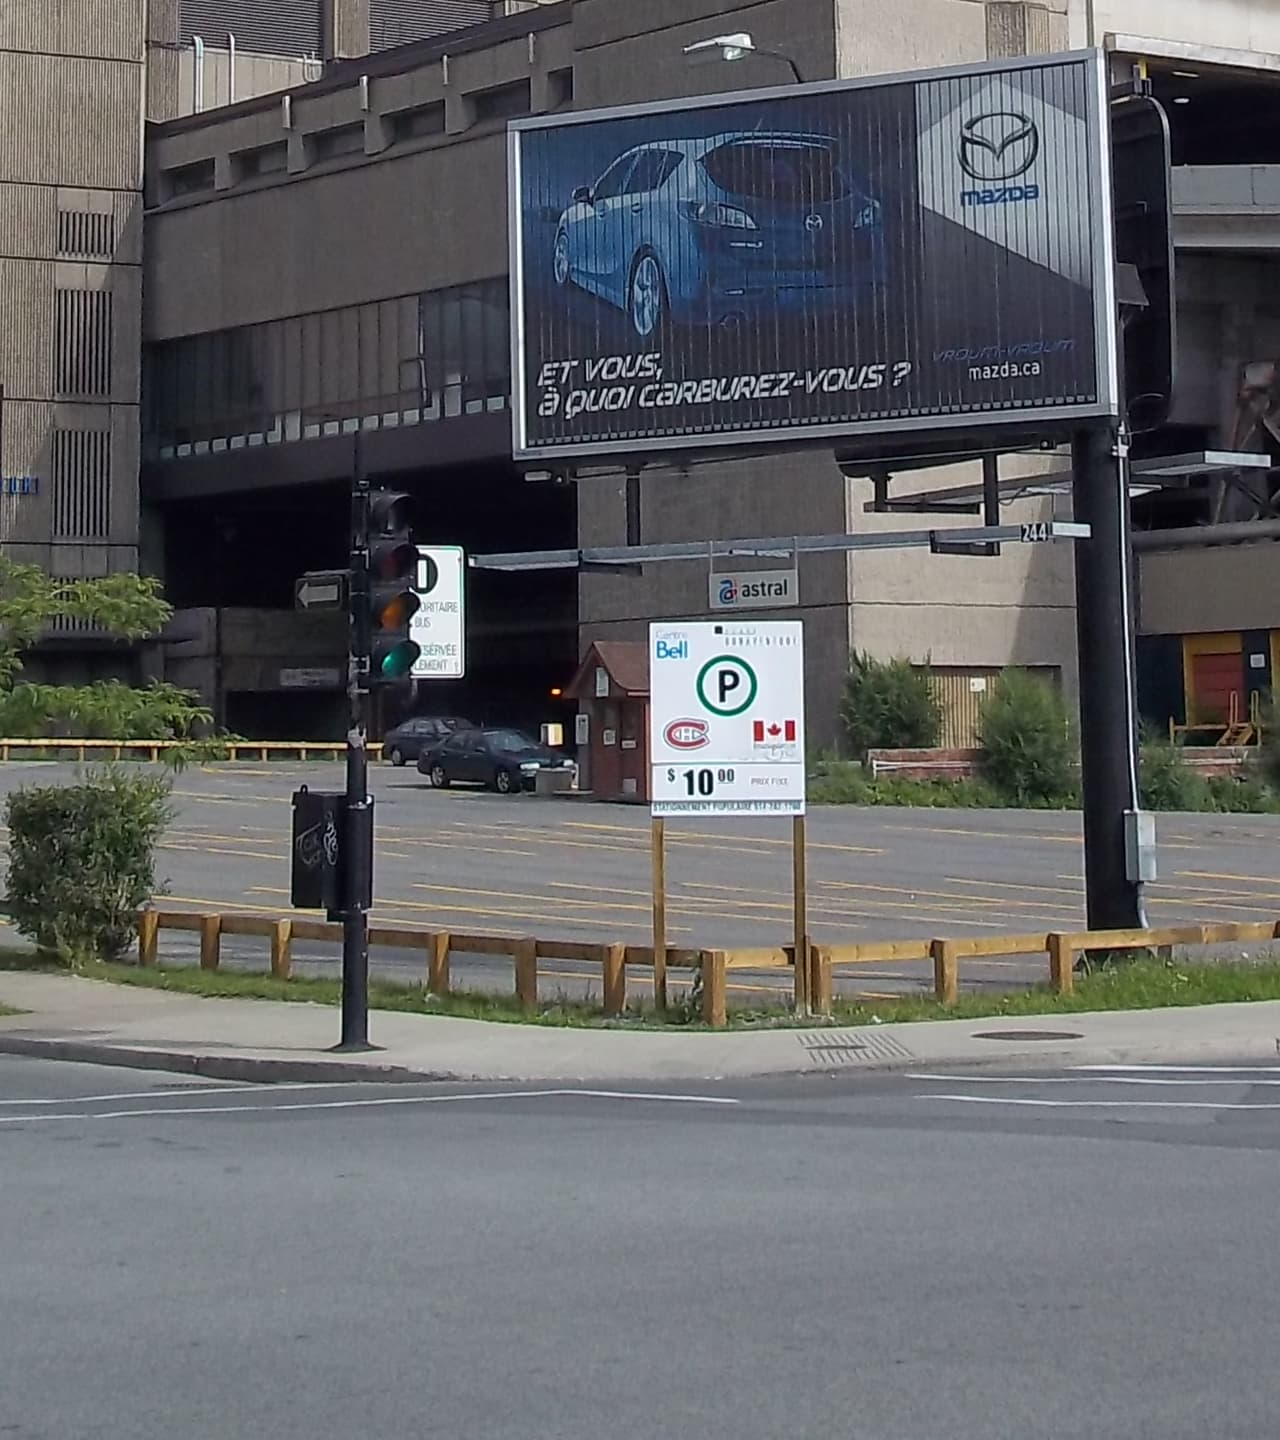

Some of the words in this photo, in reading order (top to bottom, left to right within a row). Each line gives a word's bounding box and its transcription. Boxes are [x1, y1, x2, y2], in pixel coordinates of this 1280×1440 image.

[537, 359, 579, 387] ET
[584, 352, 664, 382] VOUS,
[968, 361, 1041, 382] mazda.ca
[564, 381, 633, 420] QUOI
[741, 578, 788, 598] astral
[419, 601, 458, 614] ORITAIRE
[656, 640, 689, 660] Bell
[413, 658, 448, 671] LEMENT
[718, 669, 740, 703] P
